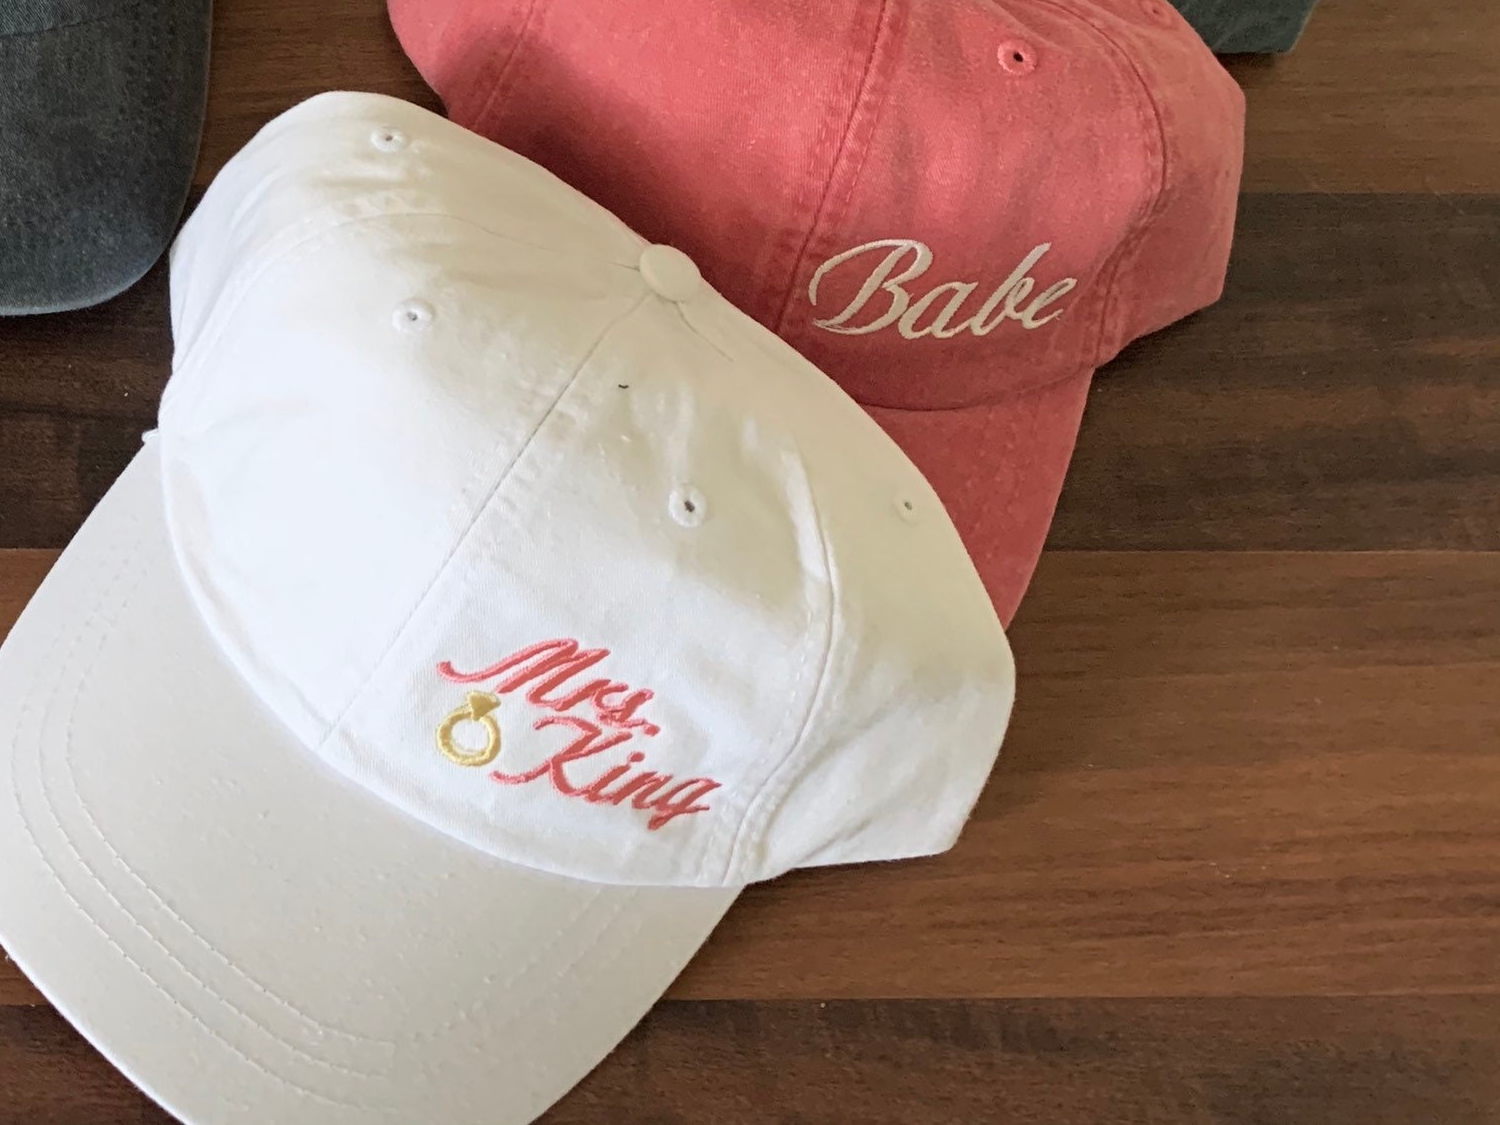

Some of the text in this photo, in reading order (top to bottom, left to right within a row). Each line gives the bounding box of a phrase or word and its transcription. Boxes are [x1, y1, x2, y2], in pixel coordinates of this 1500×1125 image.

[808, 238, 1077, 340] Babe
[436, 637, 660, 737] Mrs.
[489, 715, 722, 831] King
